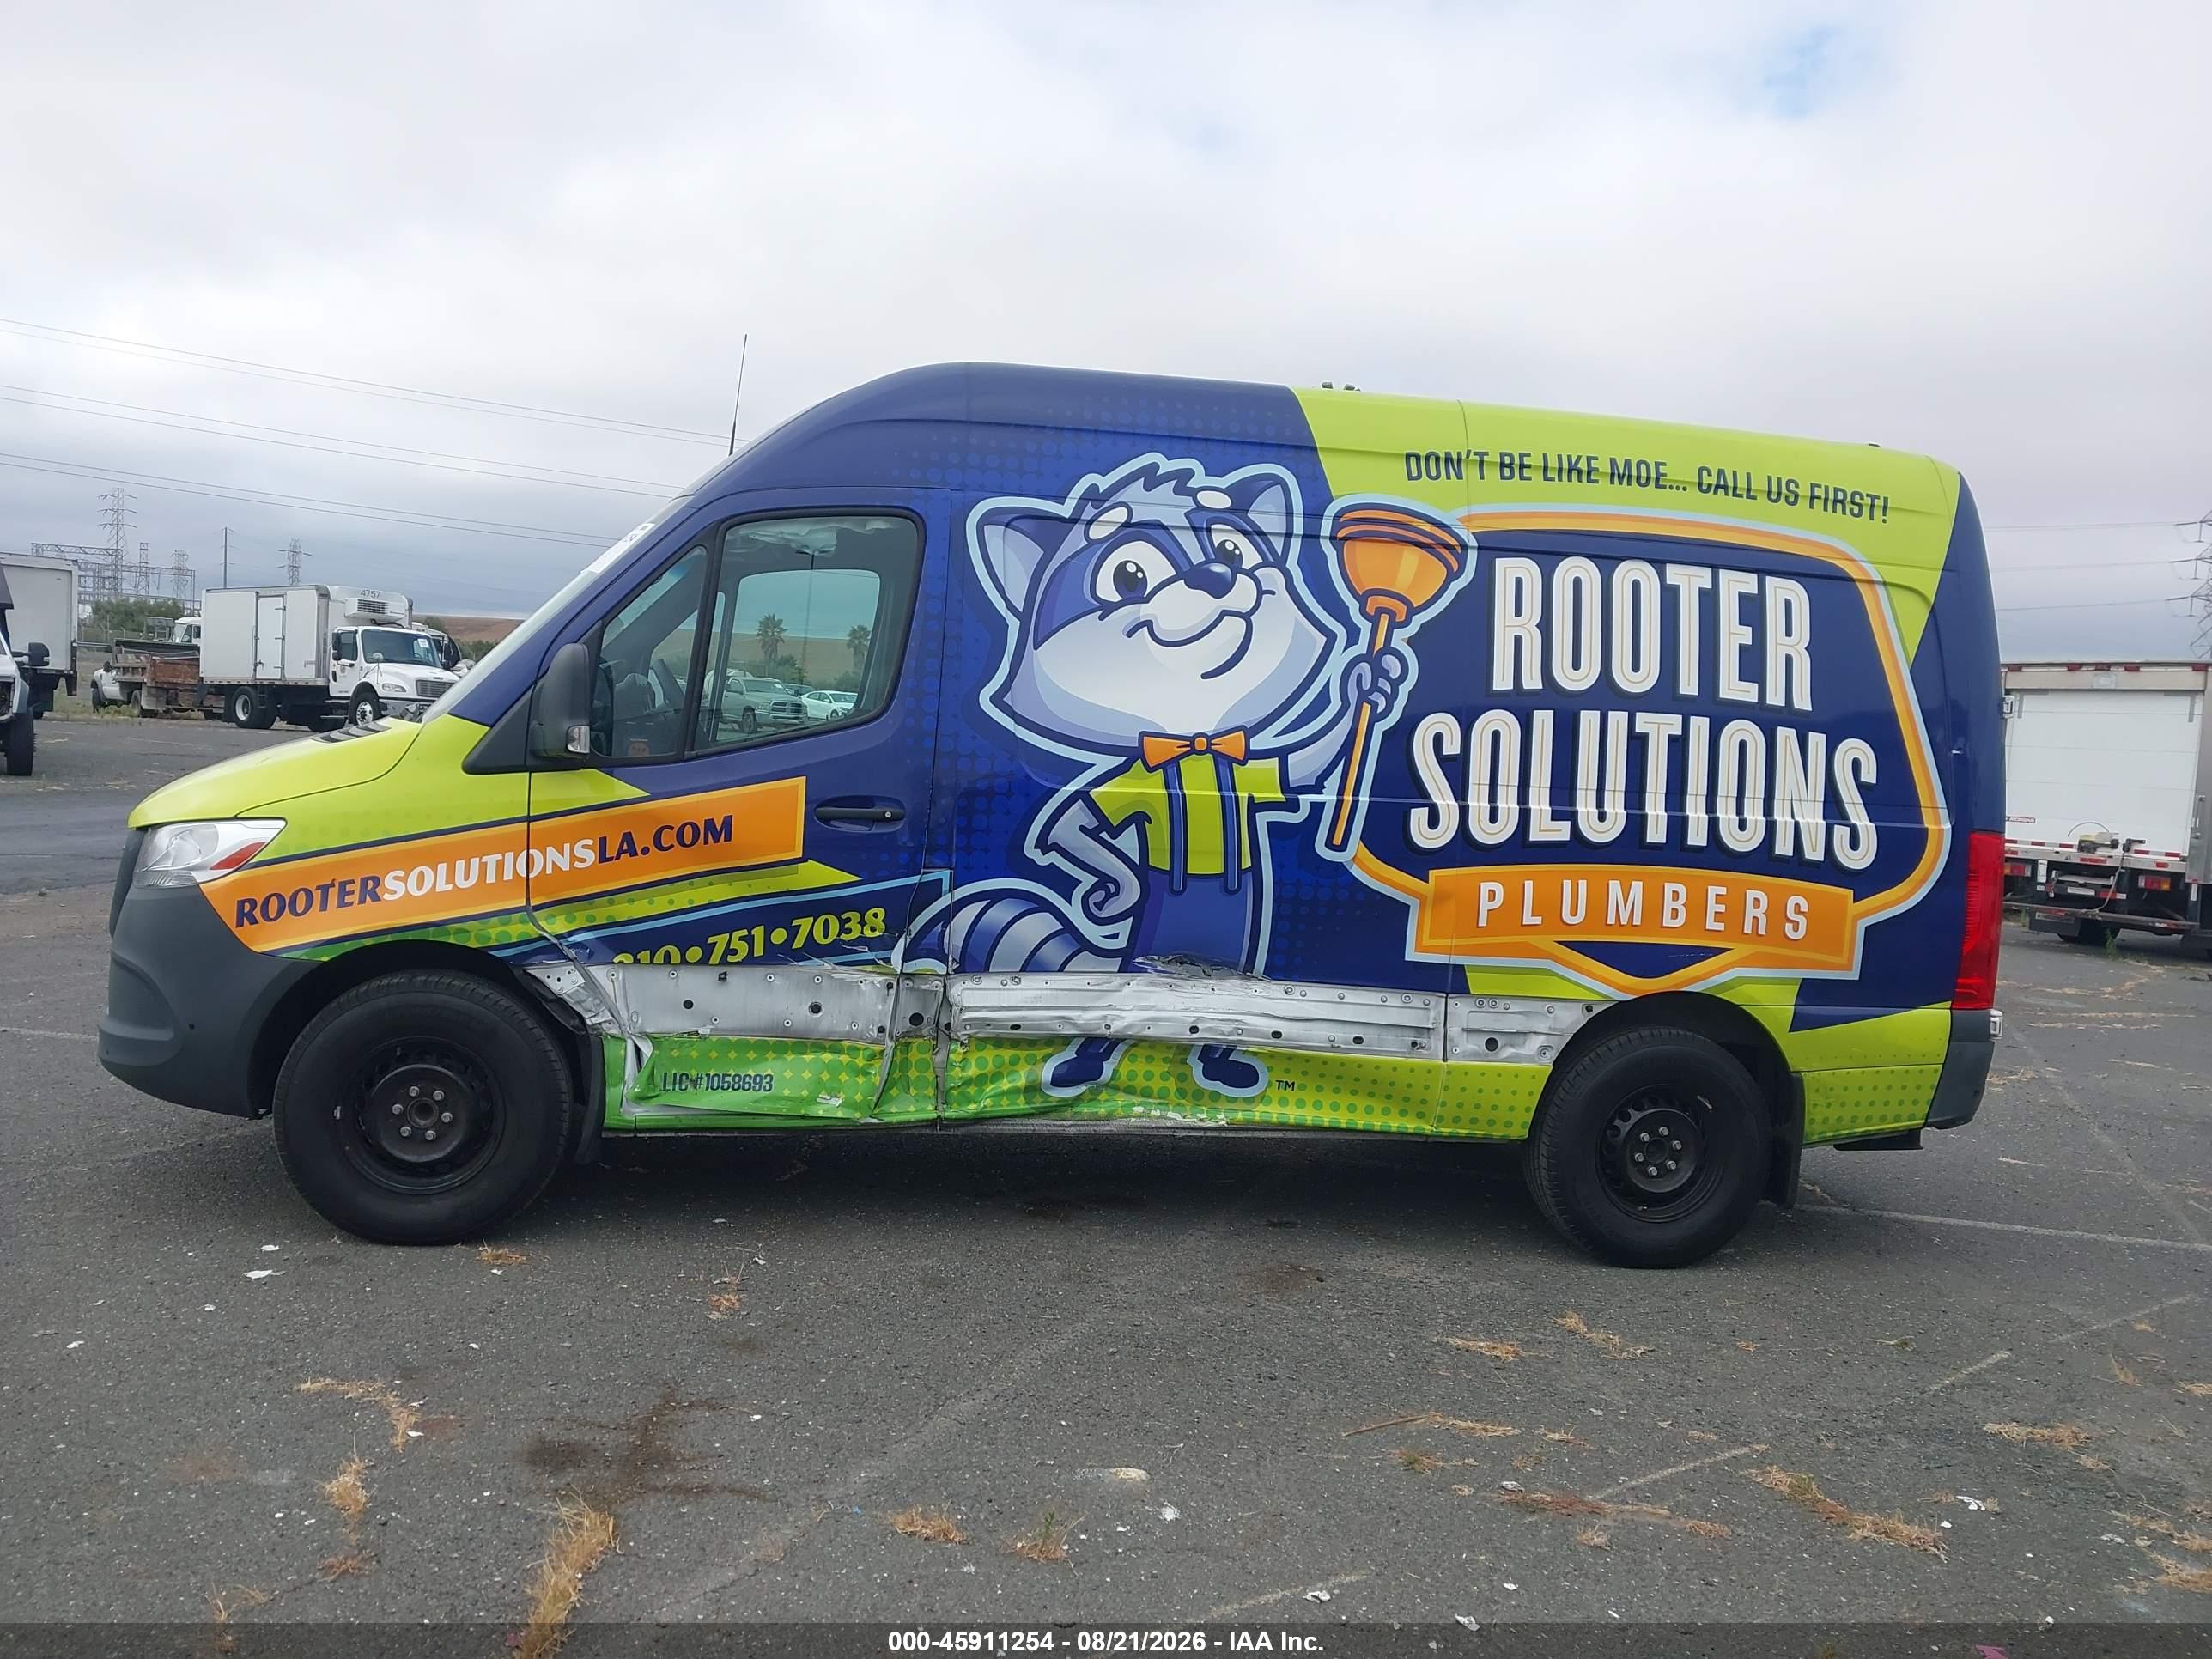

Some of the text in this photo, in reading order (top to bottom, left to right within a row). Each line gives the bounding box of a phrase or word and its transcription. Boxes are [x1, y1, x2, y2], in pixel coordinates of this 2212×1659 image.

[1405, 449, 1890, 524] DON'T BE LIKE MOE... CALL US FIRST!
[1491, 556, 1813, 713] ROOTER
[1408, 709, 1878, 871] SOLUTIONS
[1477, 880, 1809, 940] PLUMBERS
[1275, 1079, 1296, 1091] TM
